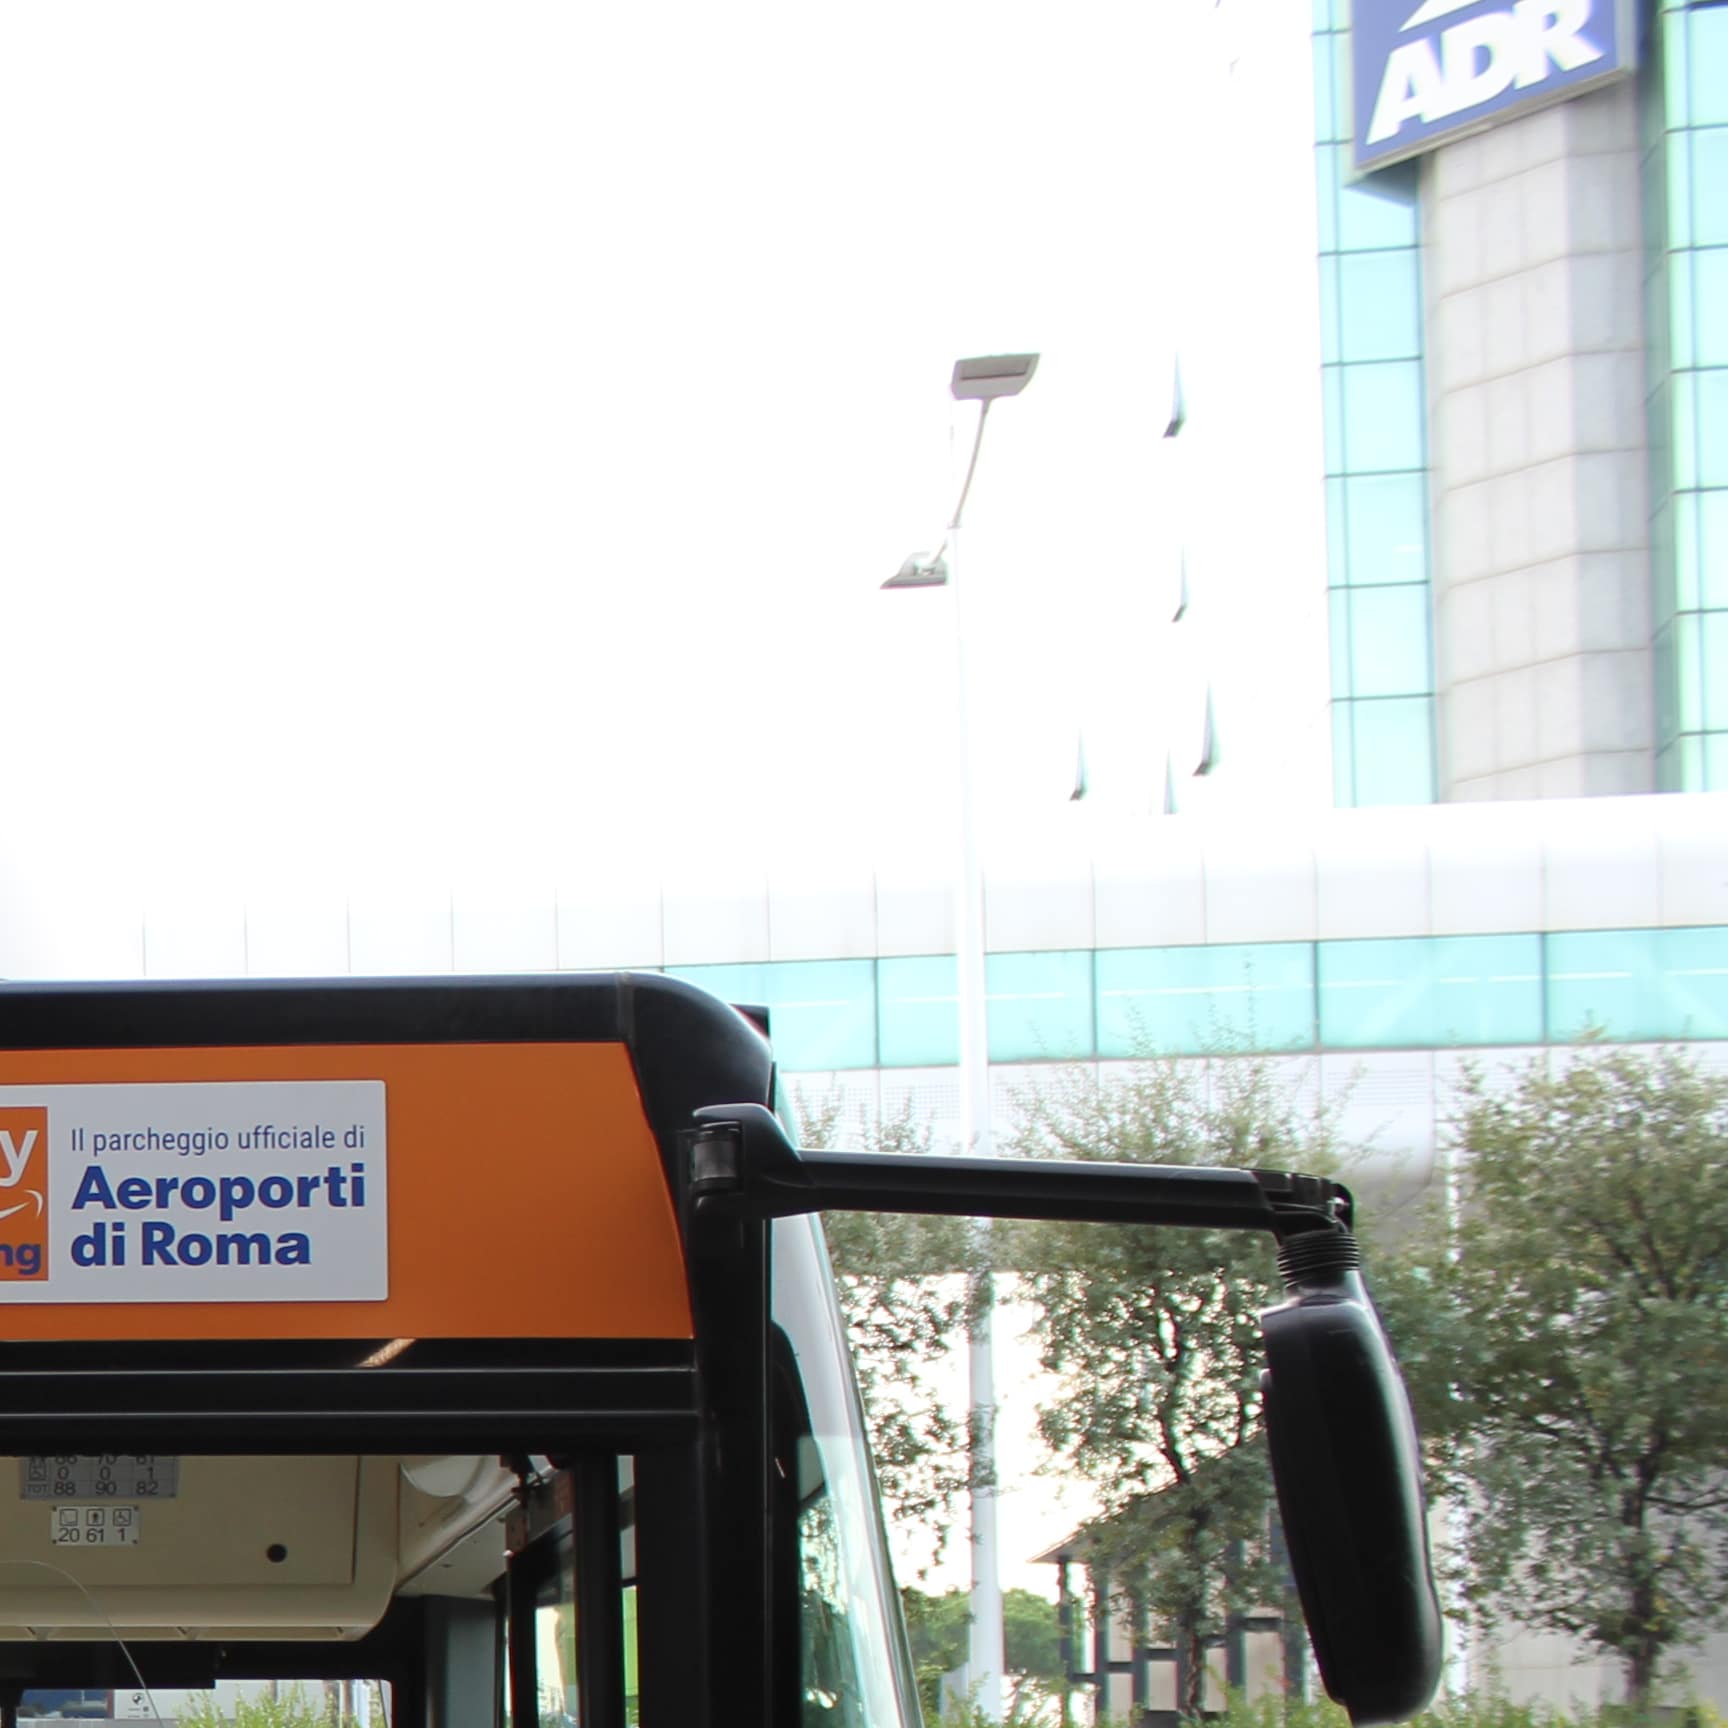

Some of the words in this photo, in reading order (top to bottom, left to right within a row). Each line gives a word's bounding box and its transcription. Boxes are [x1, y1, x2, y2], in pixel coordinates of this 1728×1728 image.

[1365, 0, 1605, 146] ADR
[70, 1128, 85, 1151] Il
[92, 1126, 229, 1156] parcheggio
[238, 1125, 336, 1150] ufficiale
[344, 1125, 366, 1149] di
[71, 1163, 366, 1222] Aeroporti
[70, 1221, 126, 1266] di
[142, 1221, 312, 1266] Roma
[53, 1480, 77, 1496] 88
[95, 1480, 118, 1496] 90
[135, 1480, 159, 1496] 82
[57, 1465, 70, 1481] 0
[99, 1465, 112, 1481] 0
[145, 1466, 155, 1481] 1
[58, 1527, 81, 1543] 20
[86, 1527, 105, 1543] 61
[117, 1528, 126, 1542] 1
